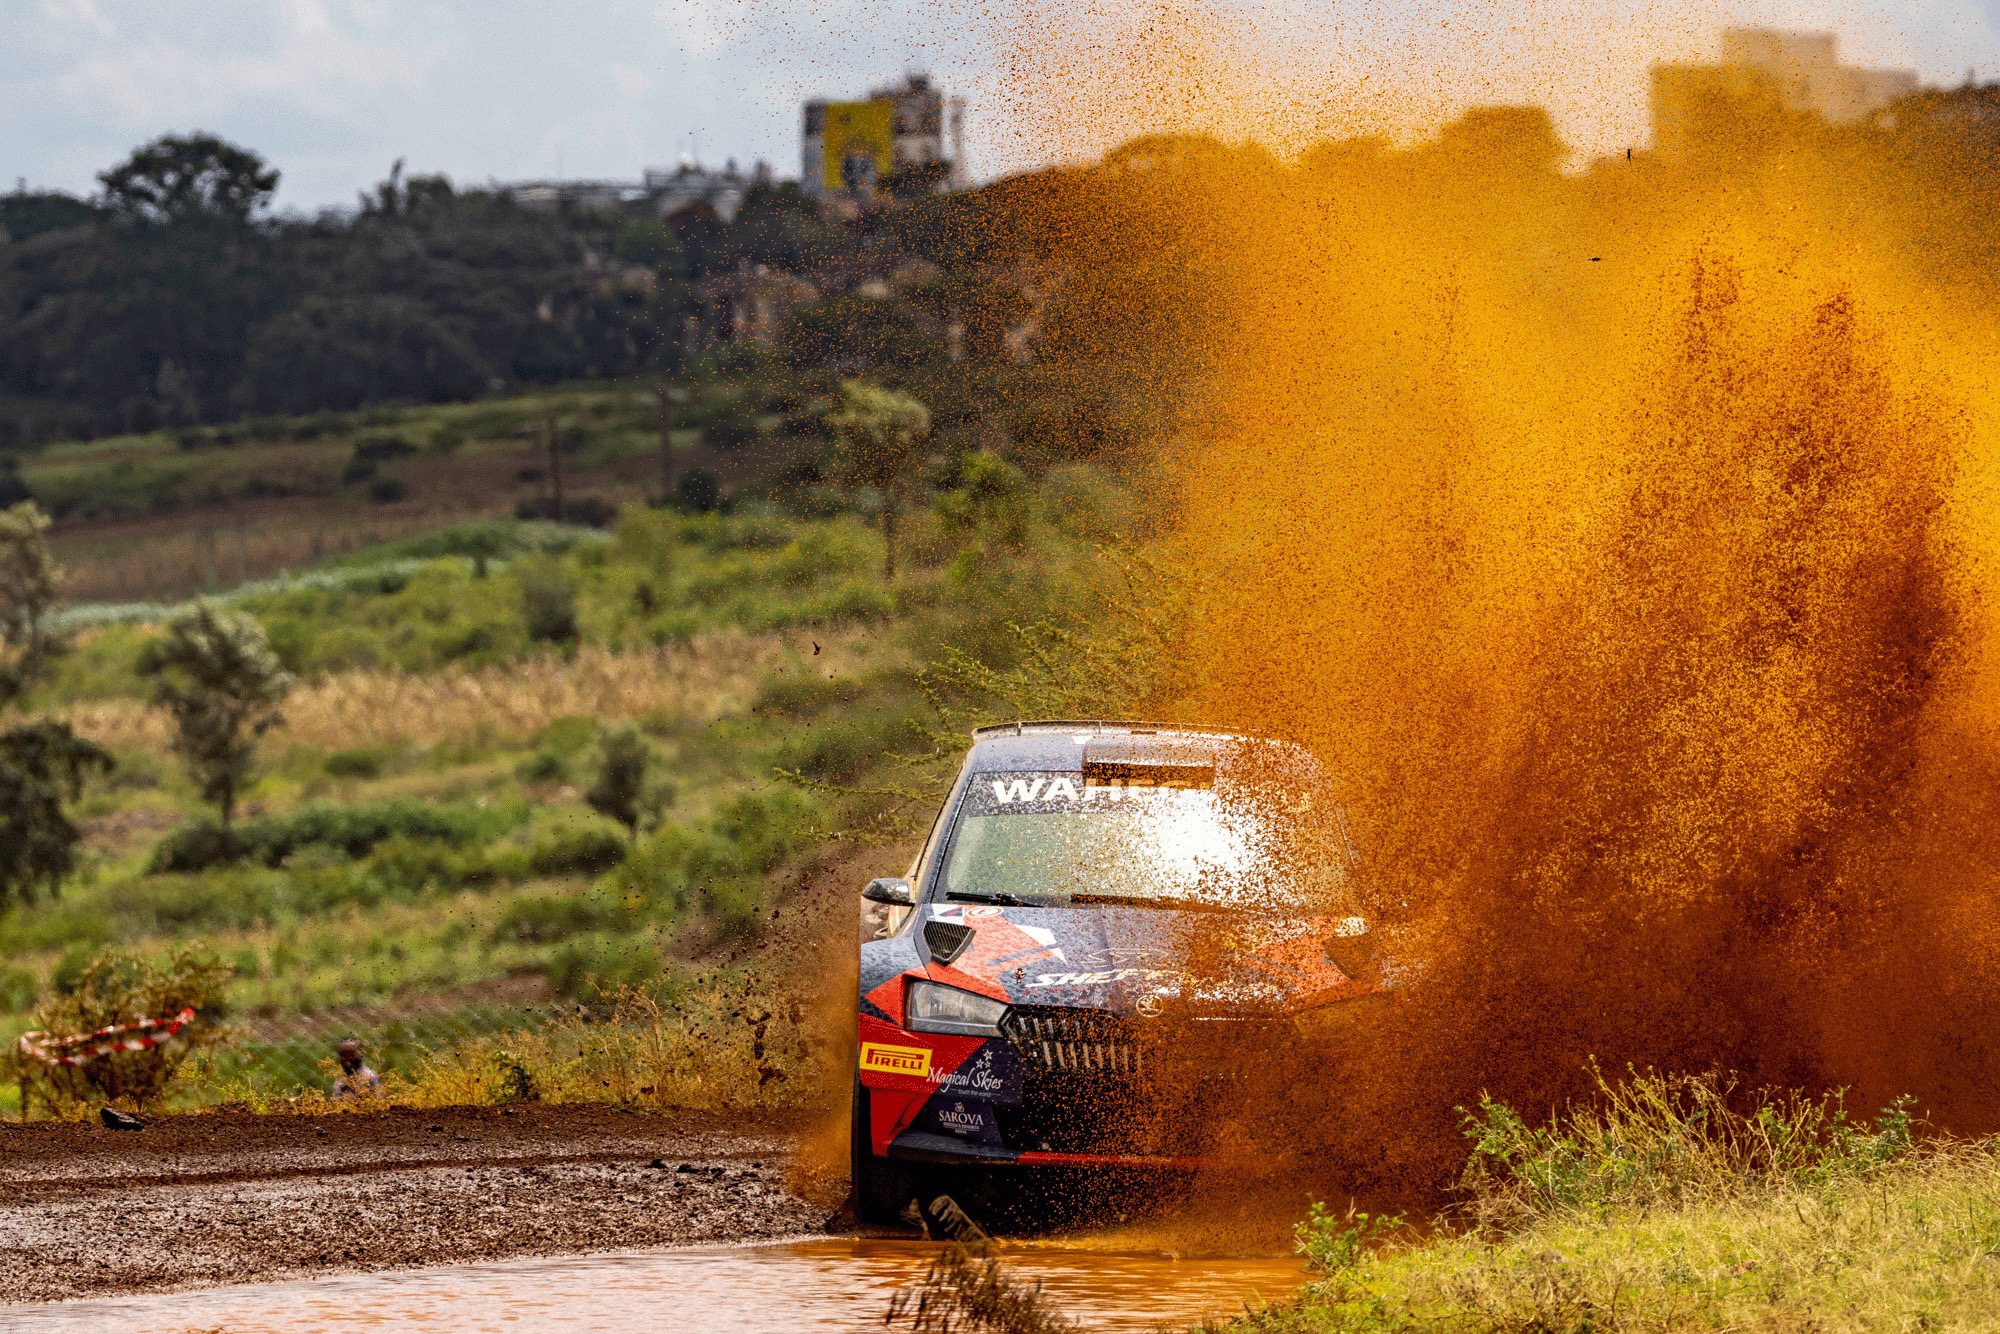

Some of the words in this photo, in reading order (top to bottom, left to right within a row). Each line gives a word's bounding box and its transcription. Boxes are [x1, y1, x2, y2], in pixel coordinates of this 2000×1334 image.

[866, 1048, 925, 1070] PIRELLI
[926, 1067, 975, 1093] Magical
[971, 1069, 1004, 1090] Skies
[939, 1110, 984, 1126] SAROVA
